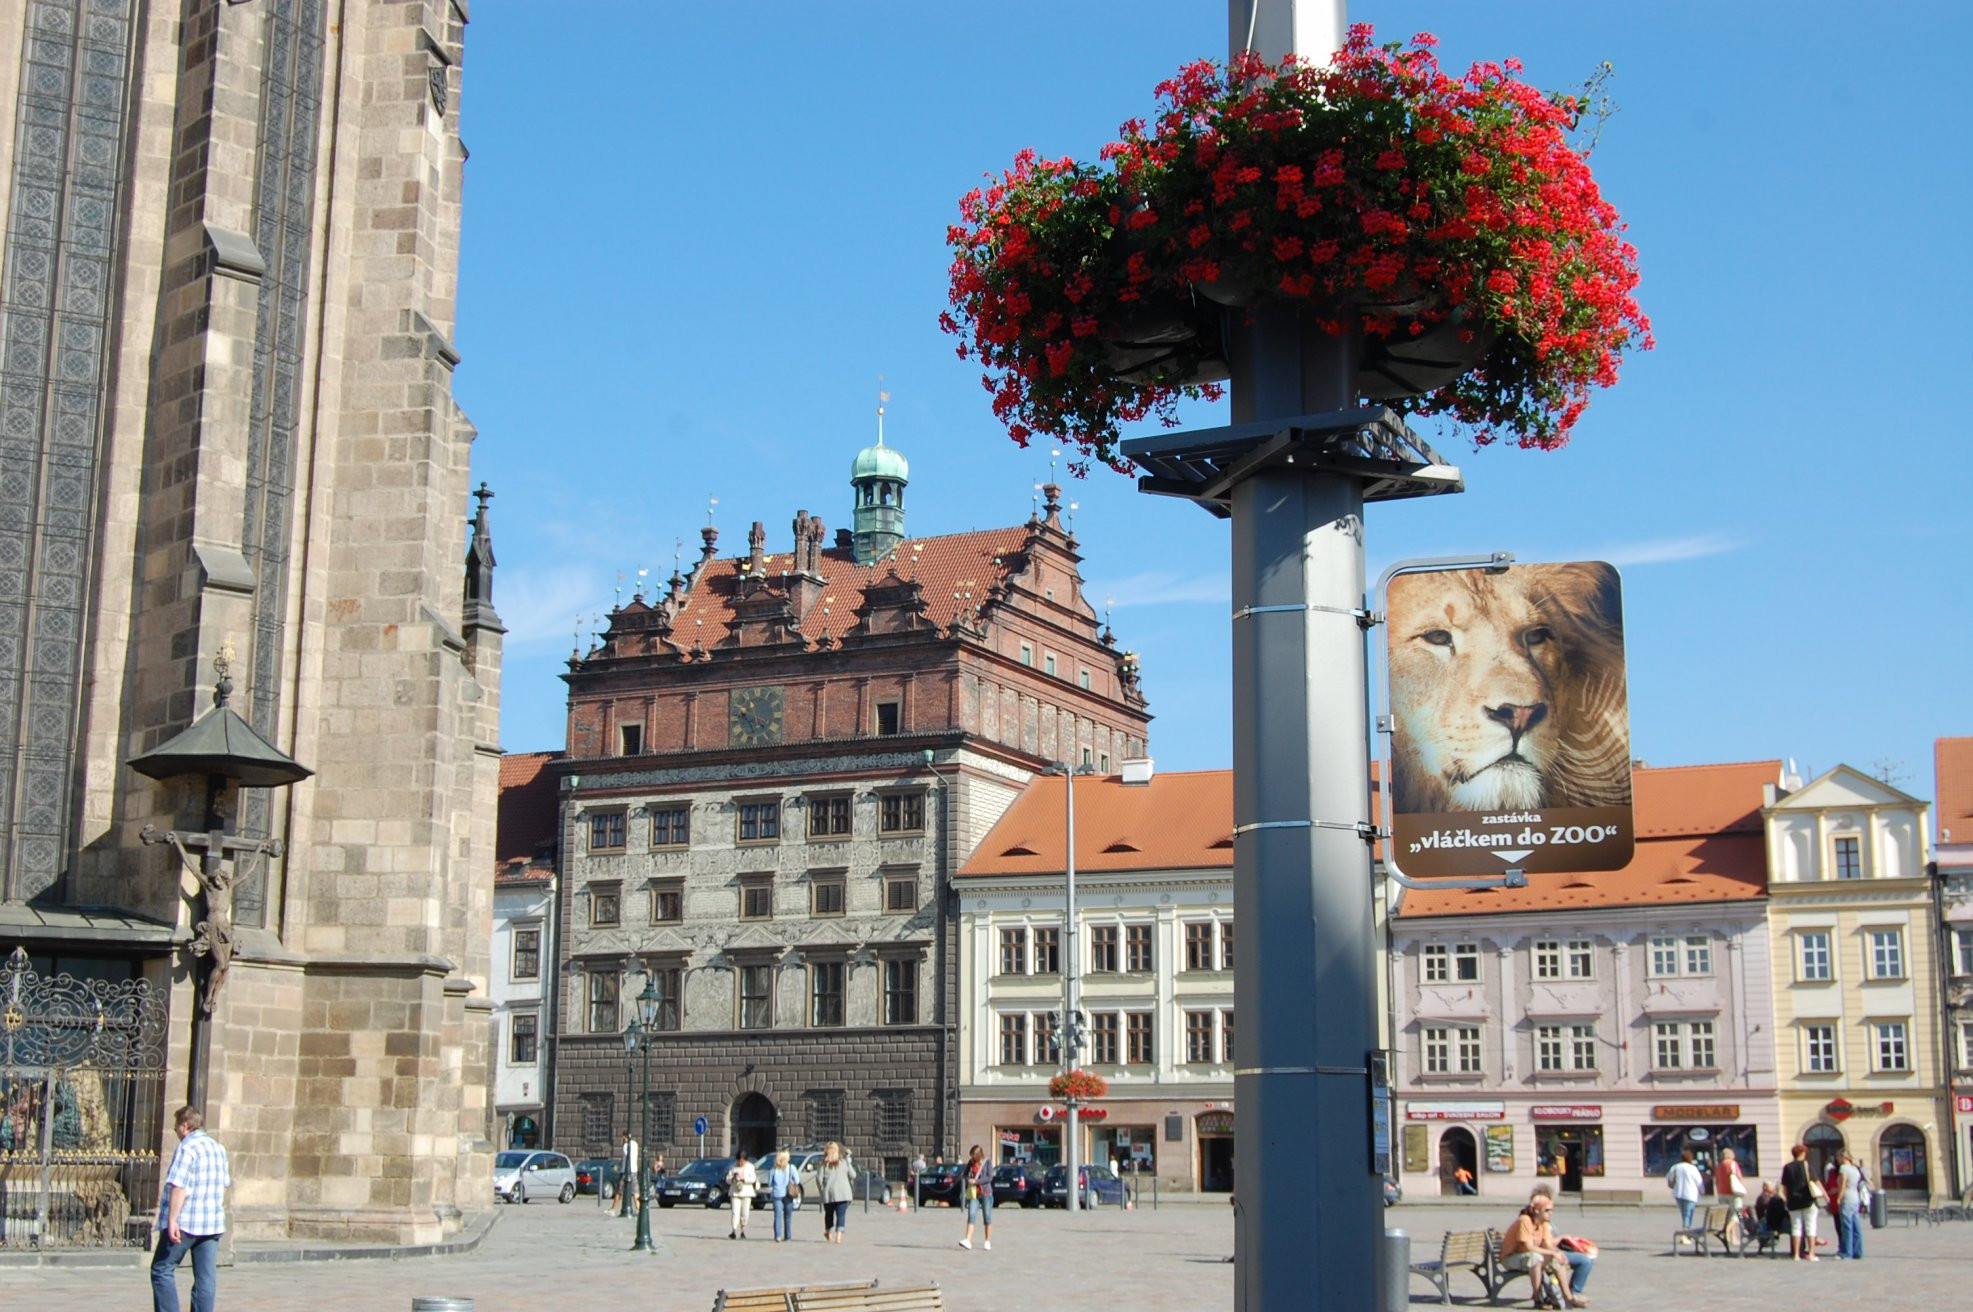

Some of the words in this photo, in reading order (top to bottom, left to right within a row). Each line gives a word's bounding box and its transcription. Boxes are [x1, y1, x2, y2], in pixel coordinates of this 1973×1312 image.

[1482, 812, 1542, 825] zastávka
[1410, 829, 1512, 854] „vláčkem
[1517, 827, 1546, 846] do
[1550, 825, 1617, 844] ZOO“
